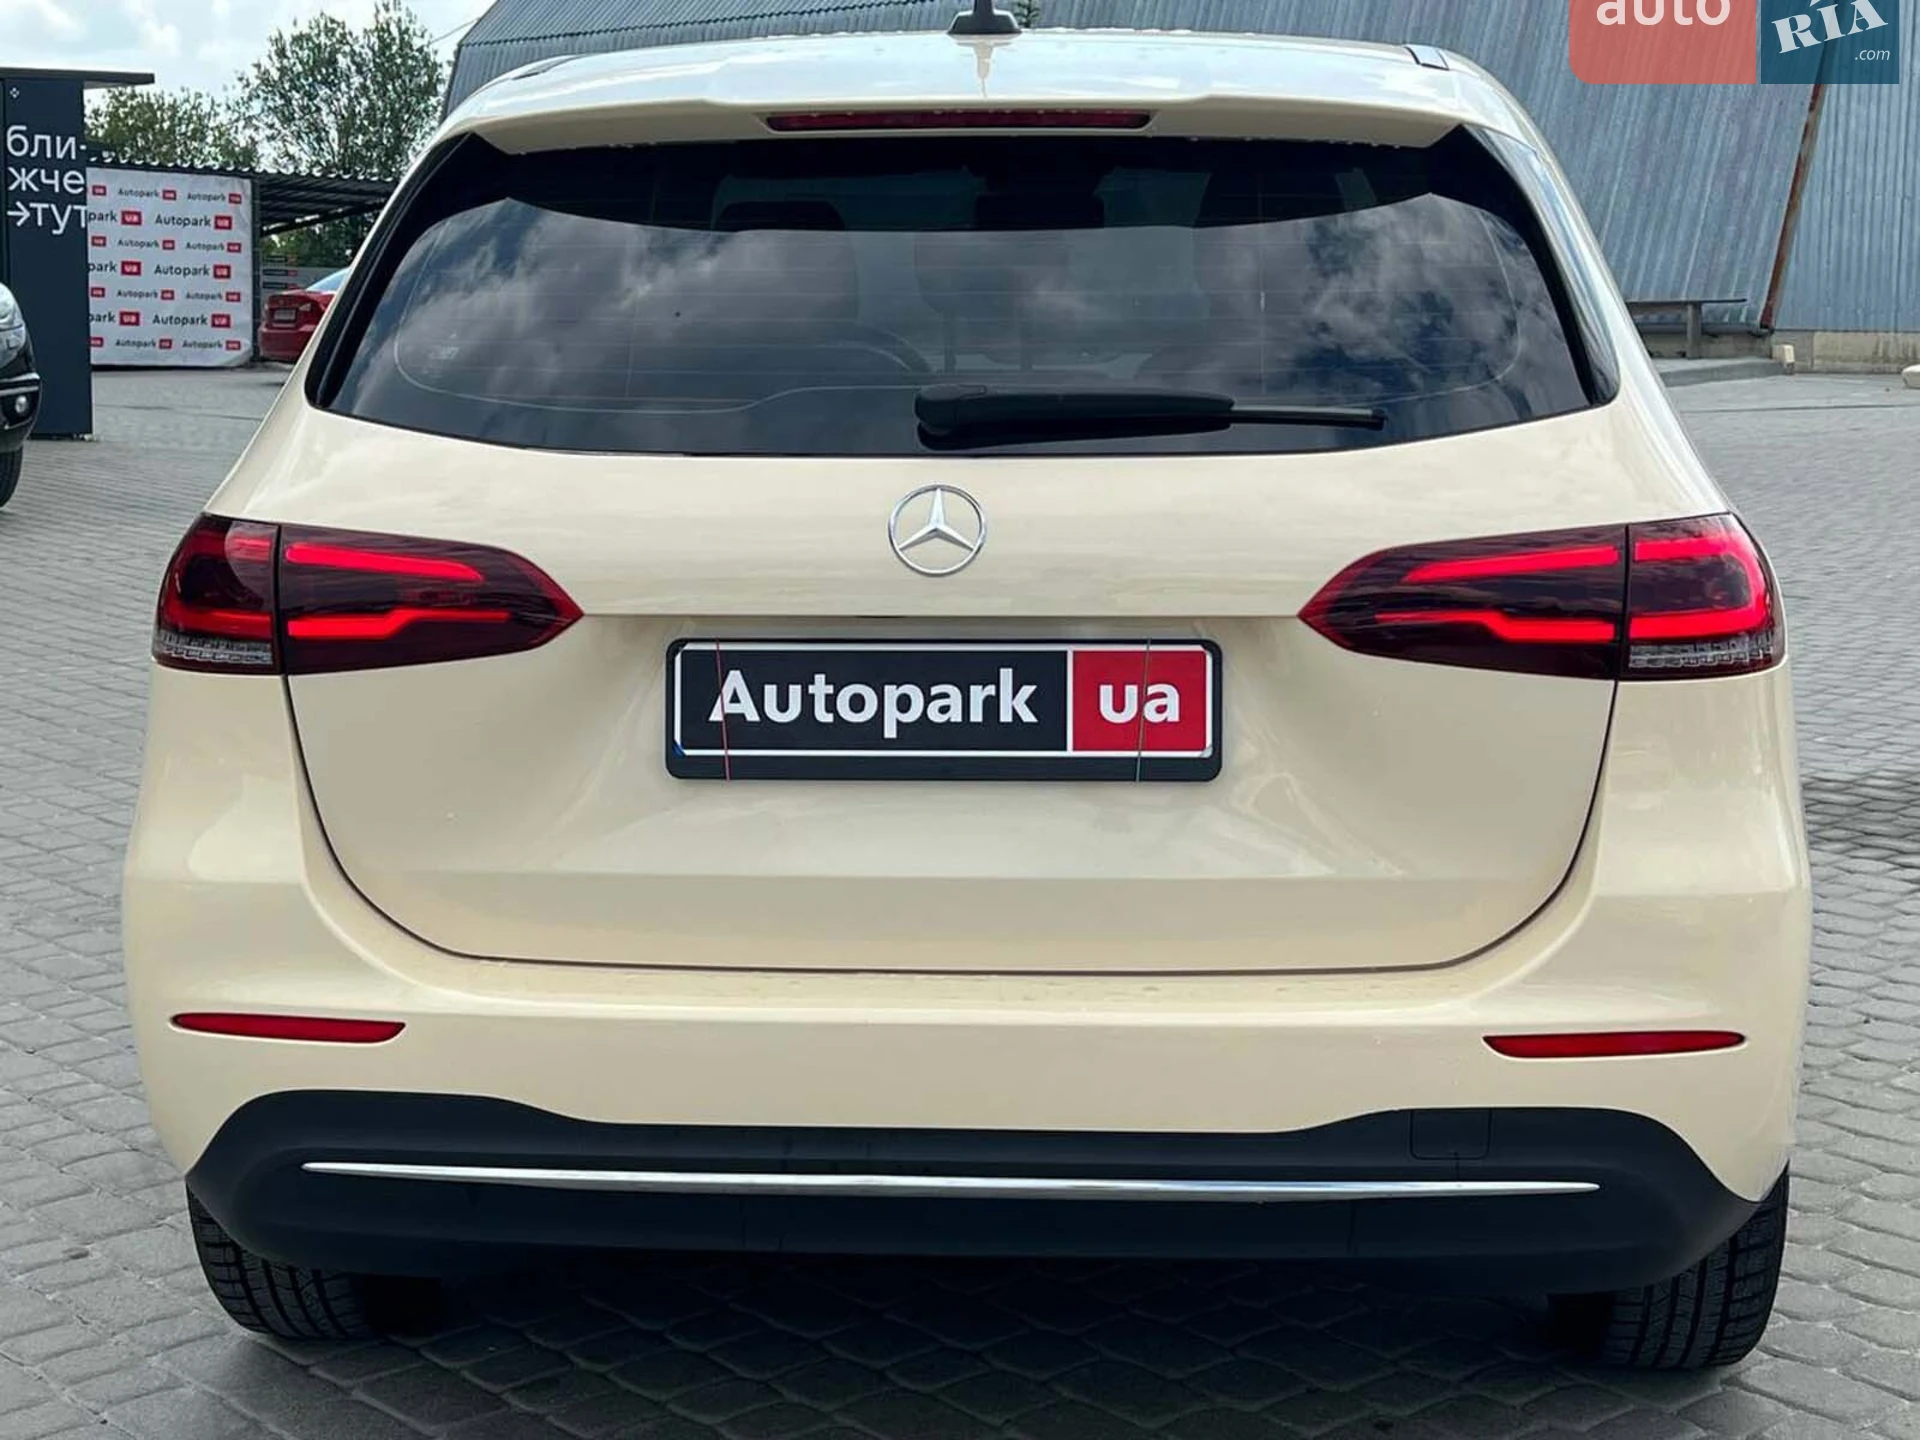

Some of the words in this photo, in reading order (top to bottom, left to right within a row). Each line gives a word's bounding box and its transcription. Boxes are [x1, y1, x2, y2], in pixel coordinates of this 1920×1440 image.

[6, 125, 87, 160] бли-
[118, 188, 159, 198] Autopark
[29, 202, 87, 235] тут
[155, 215, 211, 227] Autopark
[118, 239, 159, 248] Autopark
[154, 265, 209, 277] Autopark
[117, 290, 158, 299] Autopark
[153, 315, 207, 326] Autopark
[709, 668, 1038, 738] Autopark
[1098, 683, 1179, 723] ua
